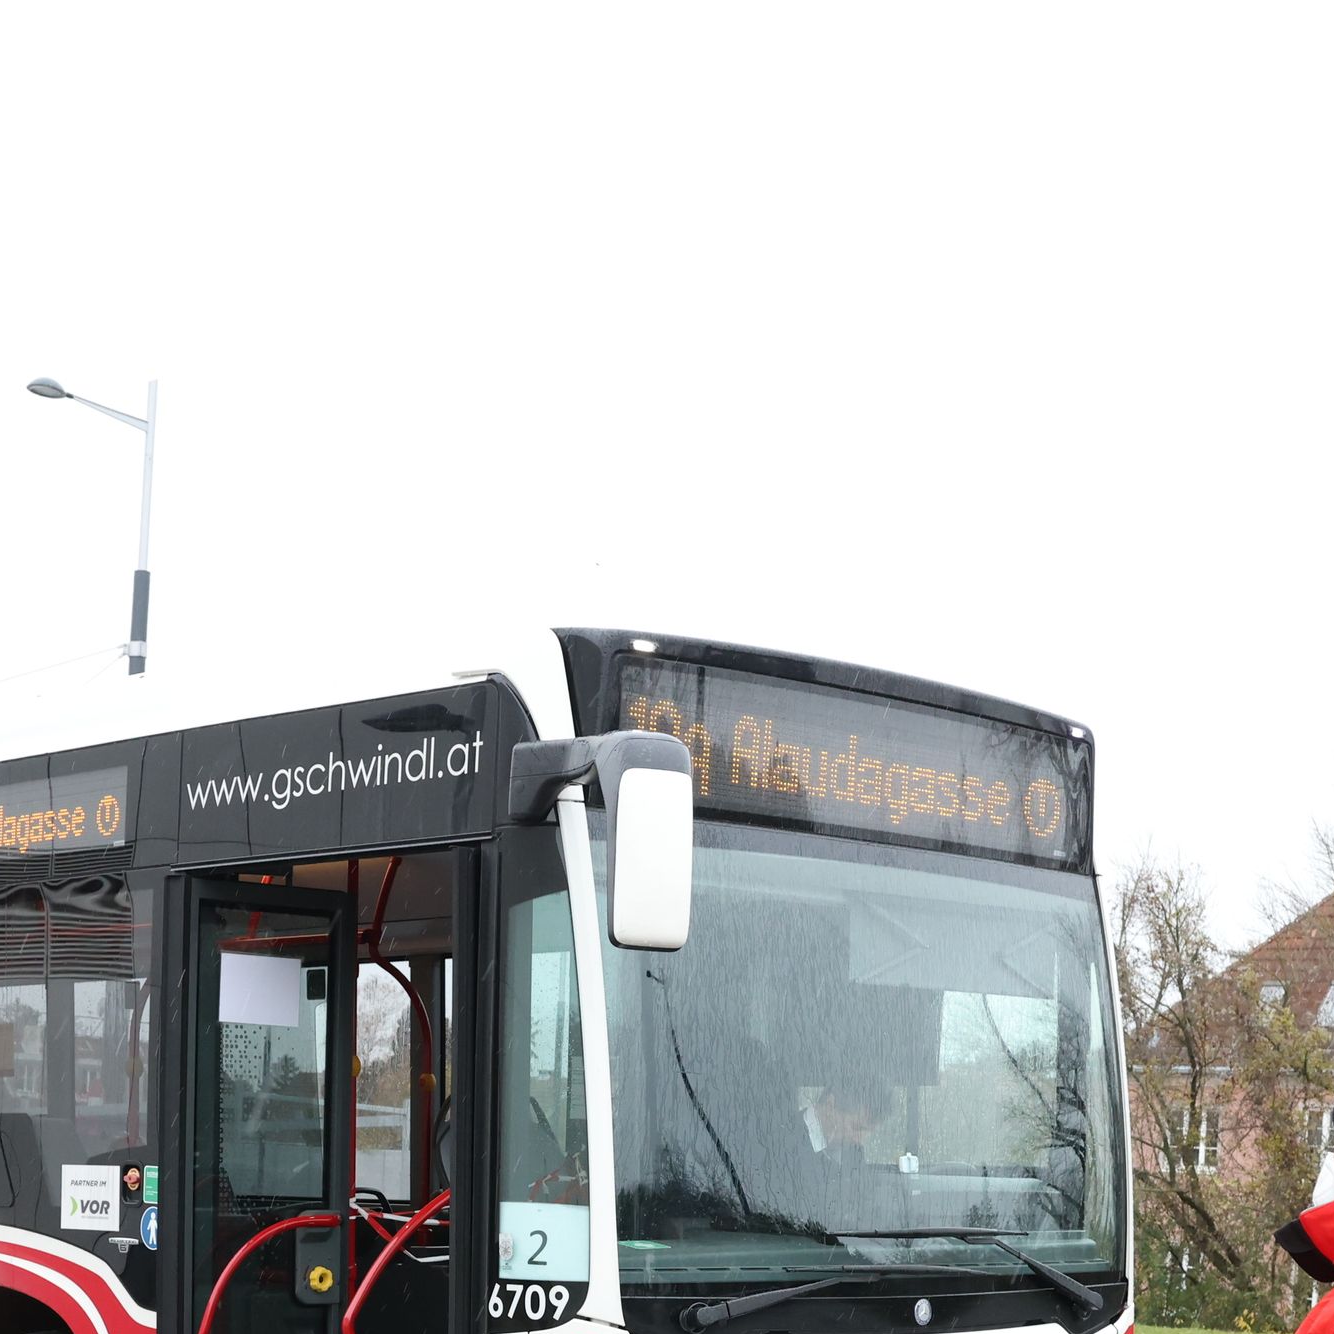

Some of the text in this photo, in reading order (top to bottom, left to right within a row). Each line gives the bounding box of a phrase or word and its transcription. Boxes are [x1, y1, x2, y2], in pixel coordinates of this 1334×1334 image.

[186, 730, 484, 810] www.gschwindl.at
[731, 714, 1010, 825] Alaudagasse
[70, 1179, 107, 1188] PARTNER IM
[80, 1199, 110, 1215] VOR
[527, 1230, 548, 1266] 2
[488, 1282, 570, 1321] 6709
